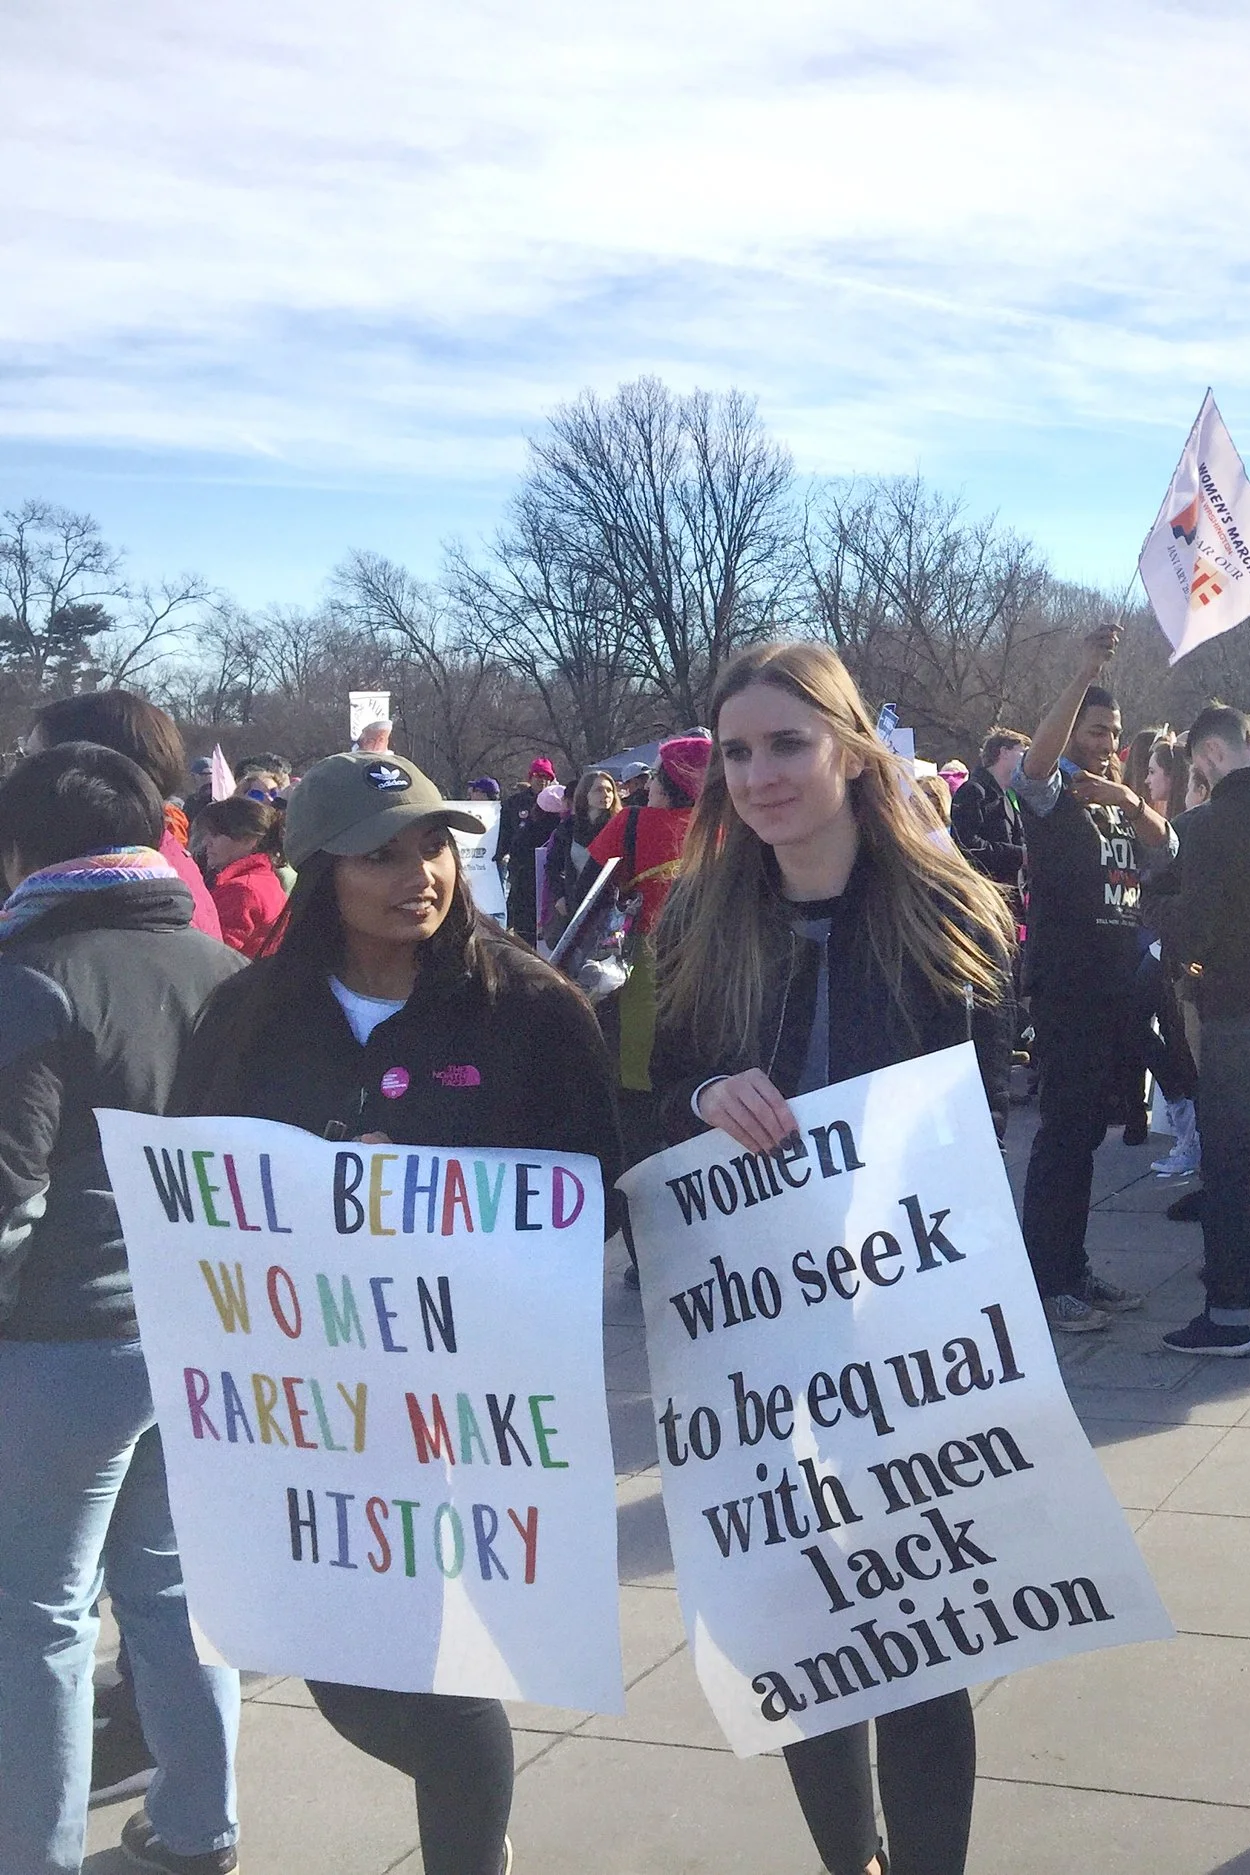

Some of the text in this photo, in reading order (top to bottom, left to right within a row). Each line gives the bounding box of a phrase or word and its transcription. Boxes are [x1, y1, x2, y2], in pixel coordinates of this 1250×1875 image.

[1198, 462, 1233, 524] WOMEN'S
[1215, 556, 1243, 581] OUR
[144, 1146, 585, 1236] WELL BEHAVED
[666, 1117, 866, 1227] women
[199, 1259, 457, 1353] WOMEN
[669, 1194, 967, 1342] who seek
[184, 1367, 569, 1470] RARELY MAKE
[659, 1303, 1026, 1468] to be equal
[287, 1487, 539, 1585] HISTORY
[702, 1426, 1034, 1558] with men
[802, 1508, 997, 1615] lack
[750, 1574, 1115, 1722] ambition
